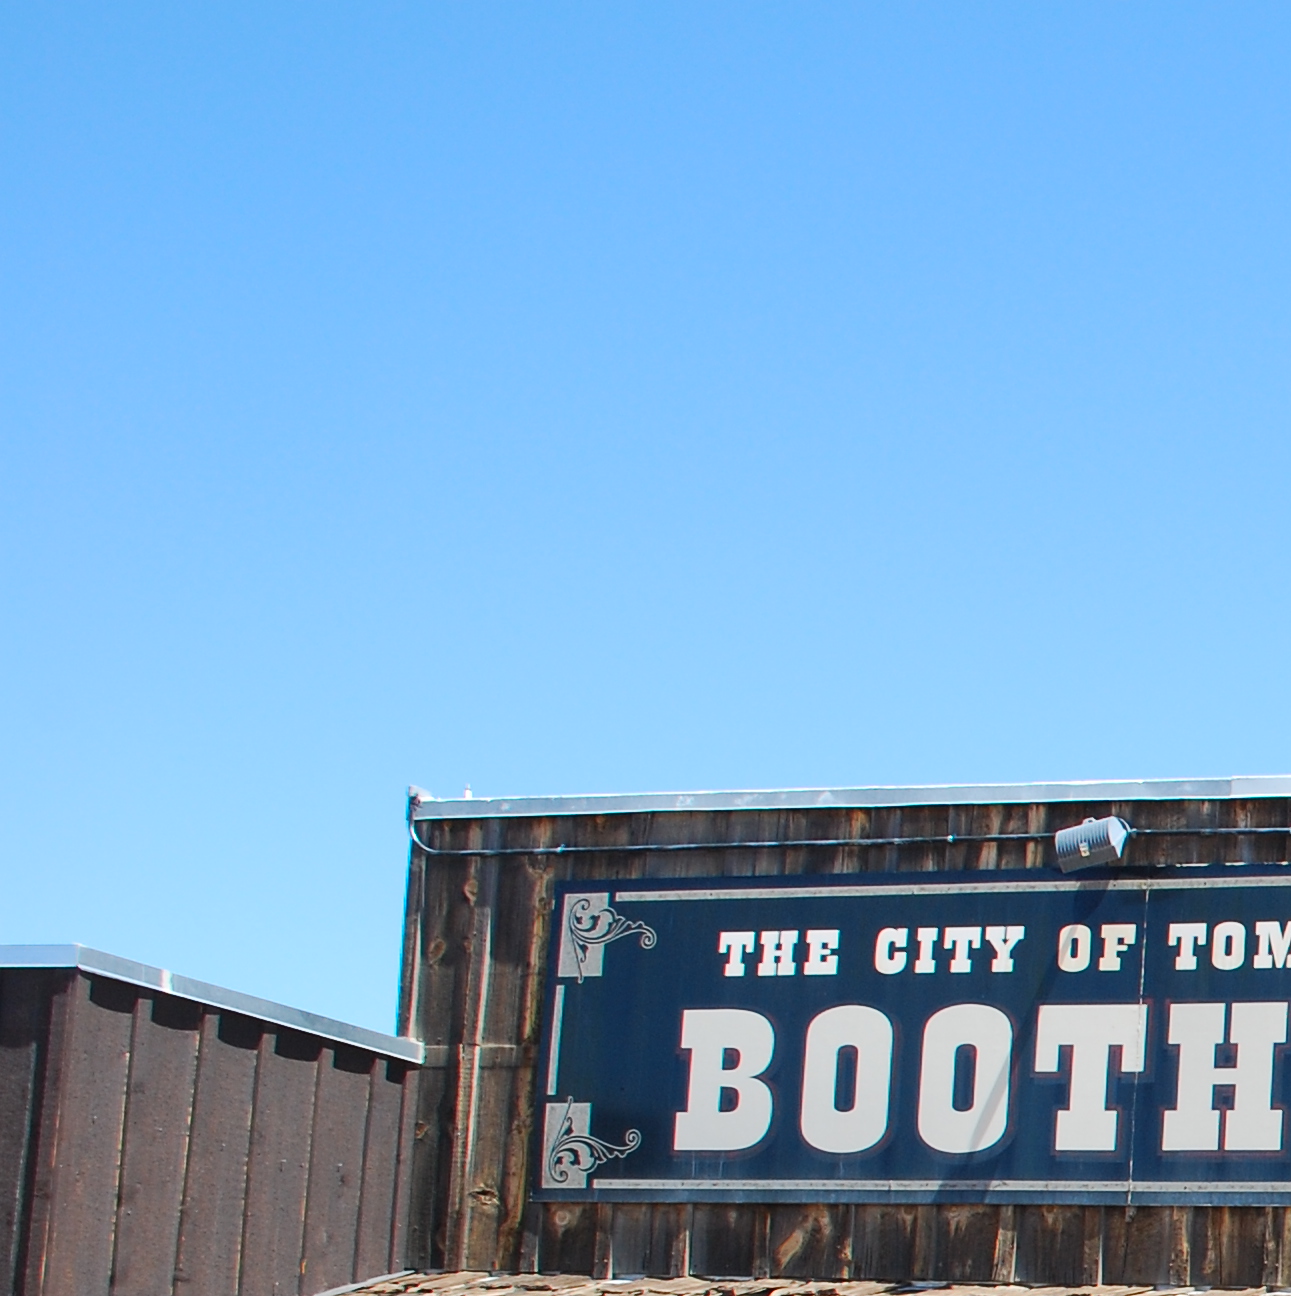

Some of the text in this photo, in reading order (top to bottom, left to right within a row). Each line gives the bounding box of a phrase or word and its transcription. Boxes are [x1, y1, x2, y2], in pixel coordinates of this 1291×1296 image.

[719, 930, 840, 977] THE
[874, 926, 1025, 975] CITY
[1058, 923, 1137, 973] OF
